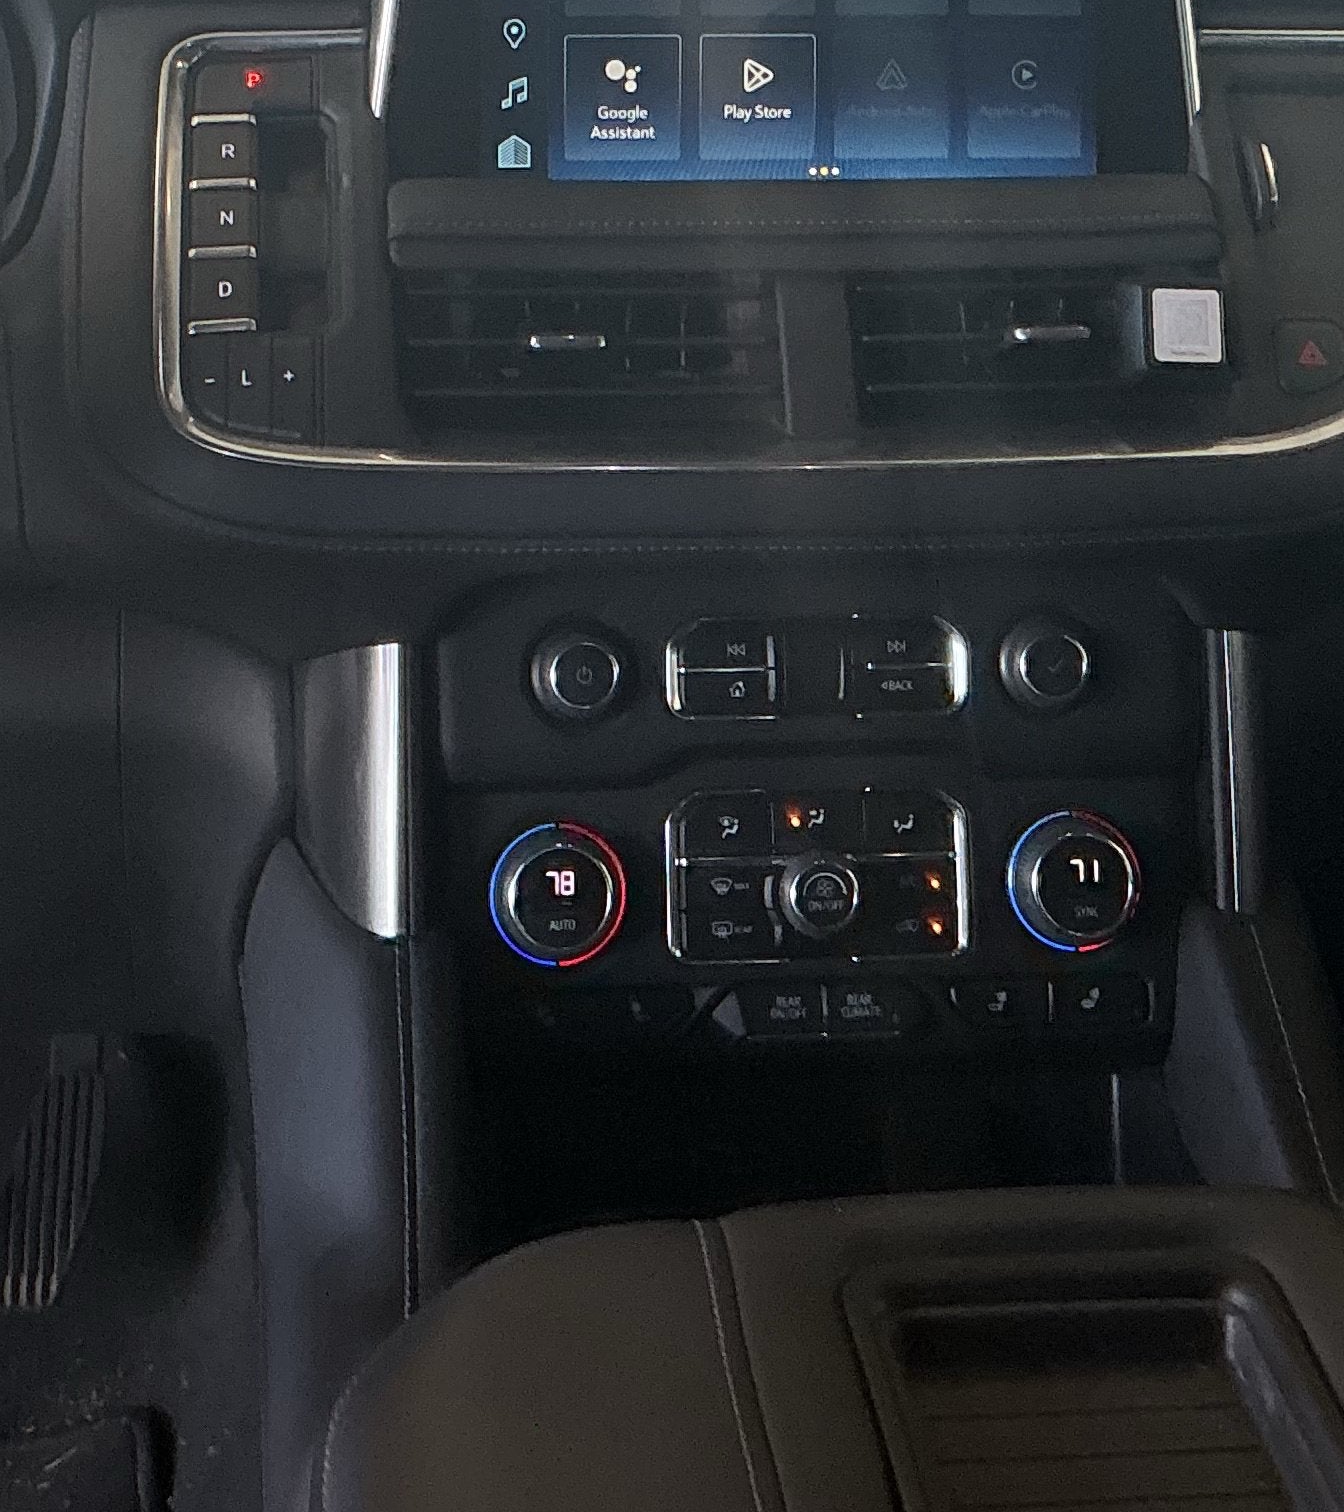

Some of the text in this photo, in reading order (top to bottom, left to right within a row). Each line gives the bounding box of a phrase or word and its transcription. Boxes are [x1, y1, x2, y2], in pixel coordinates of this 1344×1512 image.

[246, 71, 263, 88] P
[597, 104, 649, 123] Google
[723, 104, 792, 122] Play Store
[590, 124, 656, 140] Assistant
[221, 143, 236, 159] R
[220, 210, 234, 226] N
[218, 282, 233, 298] D
[241, 370, 253, 387] L
[888, 679, 913, 691] BACK
[1069, 858, 1099, 883] 71
[545, 870, 576, 896] 78
[549, 919, 576, 931] AUTO
